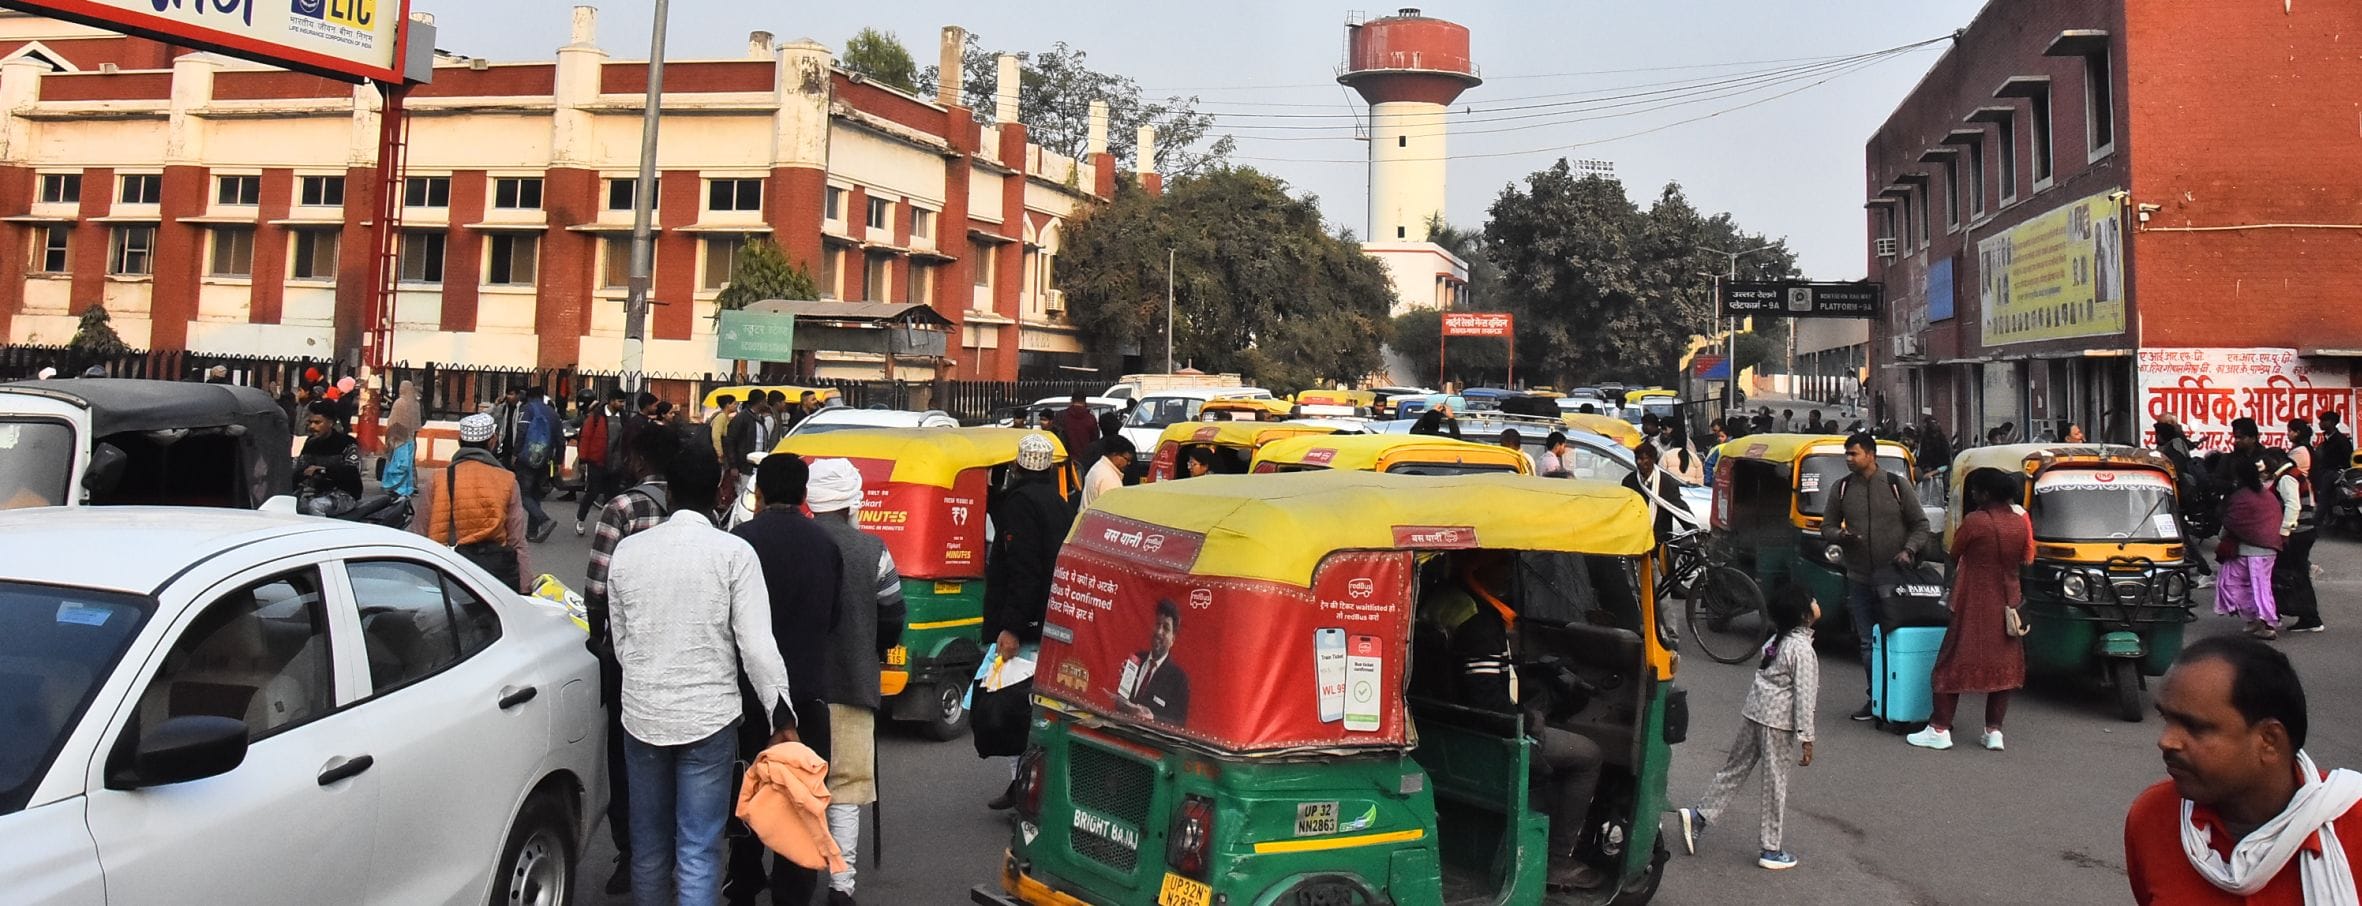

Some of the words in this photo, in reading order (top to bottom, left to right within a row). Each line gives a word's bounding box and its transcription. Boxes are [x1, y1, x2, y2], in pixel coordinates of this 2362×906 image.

[331, 0, 371, 25] LIC
[2148, 375, 2238, 427] वार्षिक
[857, 510, 908, 523] INUTES
[951, 507, 968, 526] ₹9
[1104, 528, 1118, 543] बस
[1120, 531, 1143, 548] यानी
[1411, 534, 1424, 542] बस
[1426, 531, 1442, 542] यानी
[1350, 581, 1373, 591] redBus
[1907, 585, 1941, 593] PARMAR
[1071, 590, 1113, 611] confirmed
[1355, 603, 1388, 612] waitlisted
[1344, 613, 1368, 621] redBus
[1323, 685, 1336, 695] WL
[1304, 804, 1318, 818] UP
[1320, 804, 1332, 816] 32
[1073, 809, 1110, 838] BRIGHT
[1110, 823, 1139, 850] BAJAJ
[1299, 819, 1335, 833] NN2863
[1169, 878, 1204, 901] UP32N
